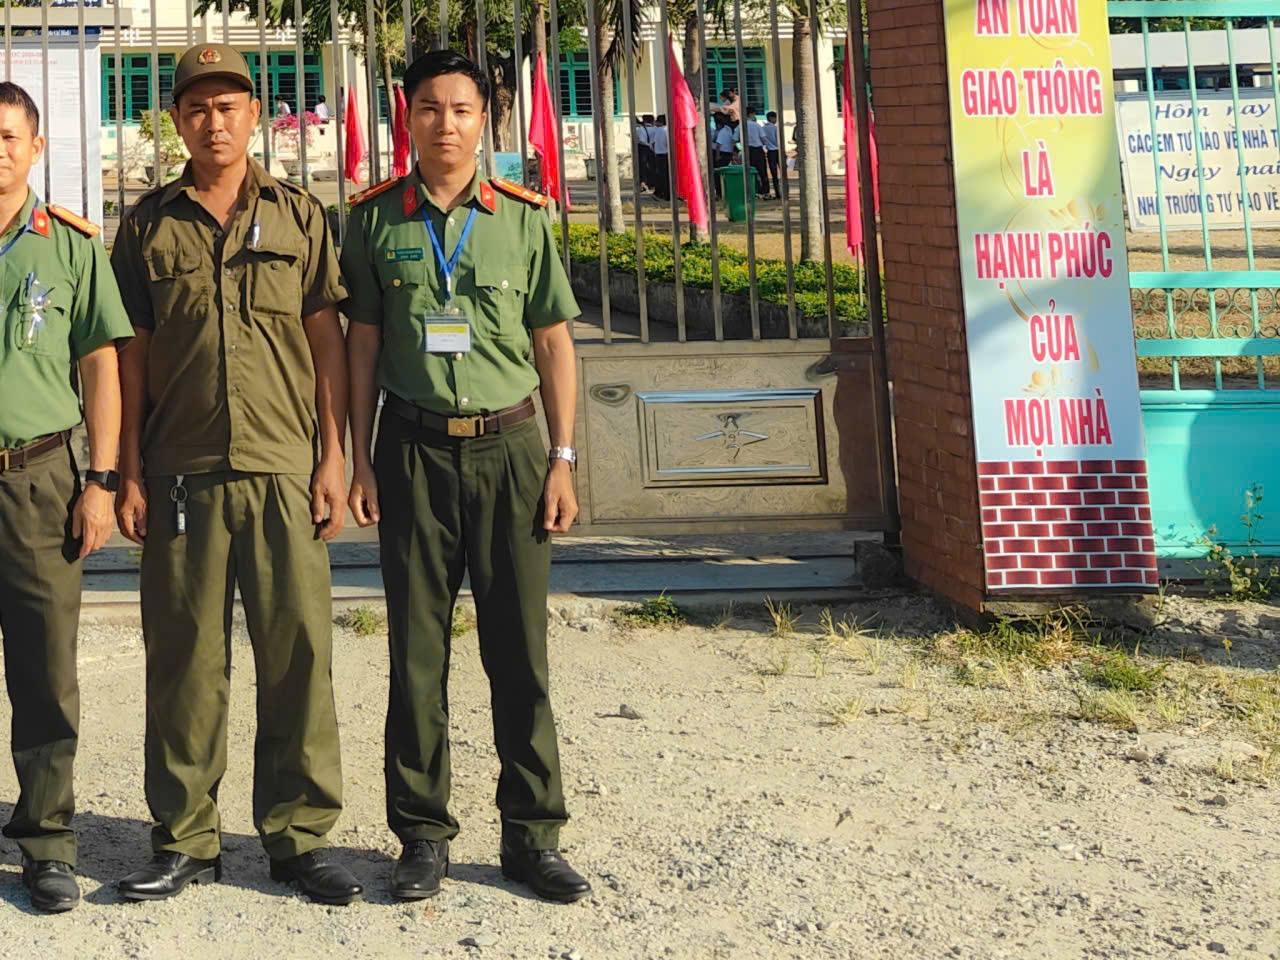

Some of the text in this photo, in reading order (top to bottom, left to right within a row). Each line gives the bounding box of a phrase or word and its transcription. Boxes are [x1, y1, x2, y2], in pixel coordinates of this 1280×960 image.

[961, 60, 1103, 116] GIAO THÔNG
[1128, 129, 1152, 154] CÁC
[1242, 124, 1269, 149] NHÀ
[1022, 145, 1054, 196] LÀ
[975, 222, 1113, 289] HẠNH PHÚC
[1029, 298, 1081, 361] CỦA
[1004, 388, 1113, 457] MỌI NHÀ
